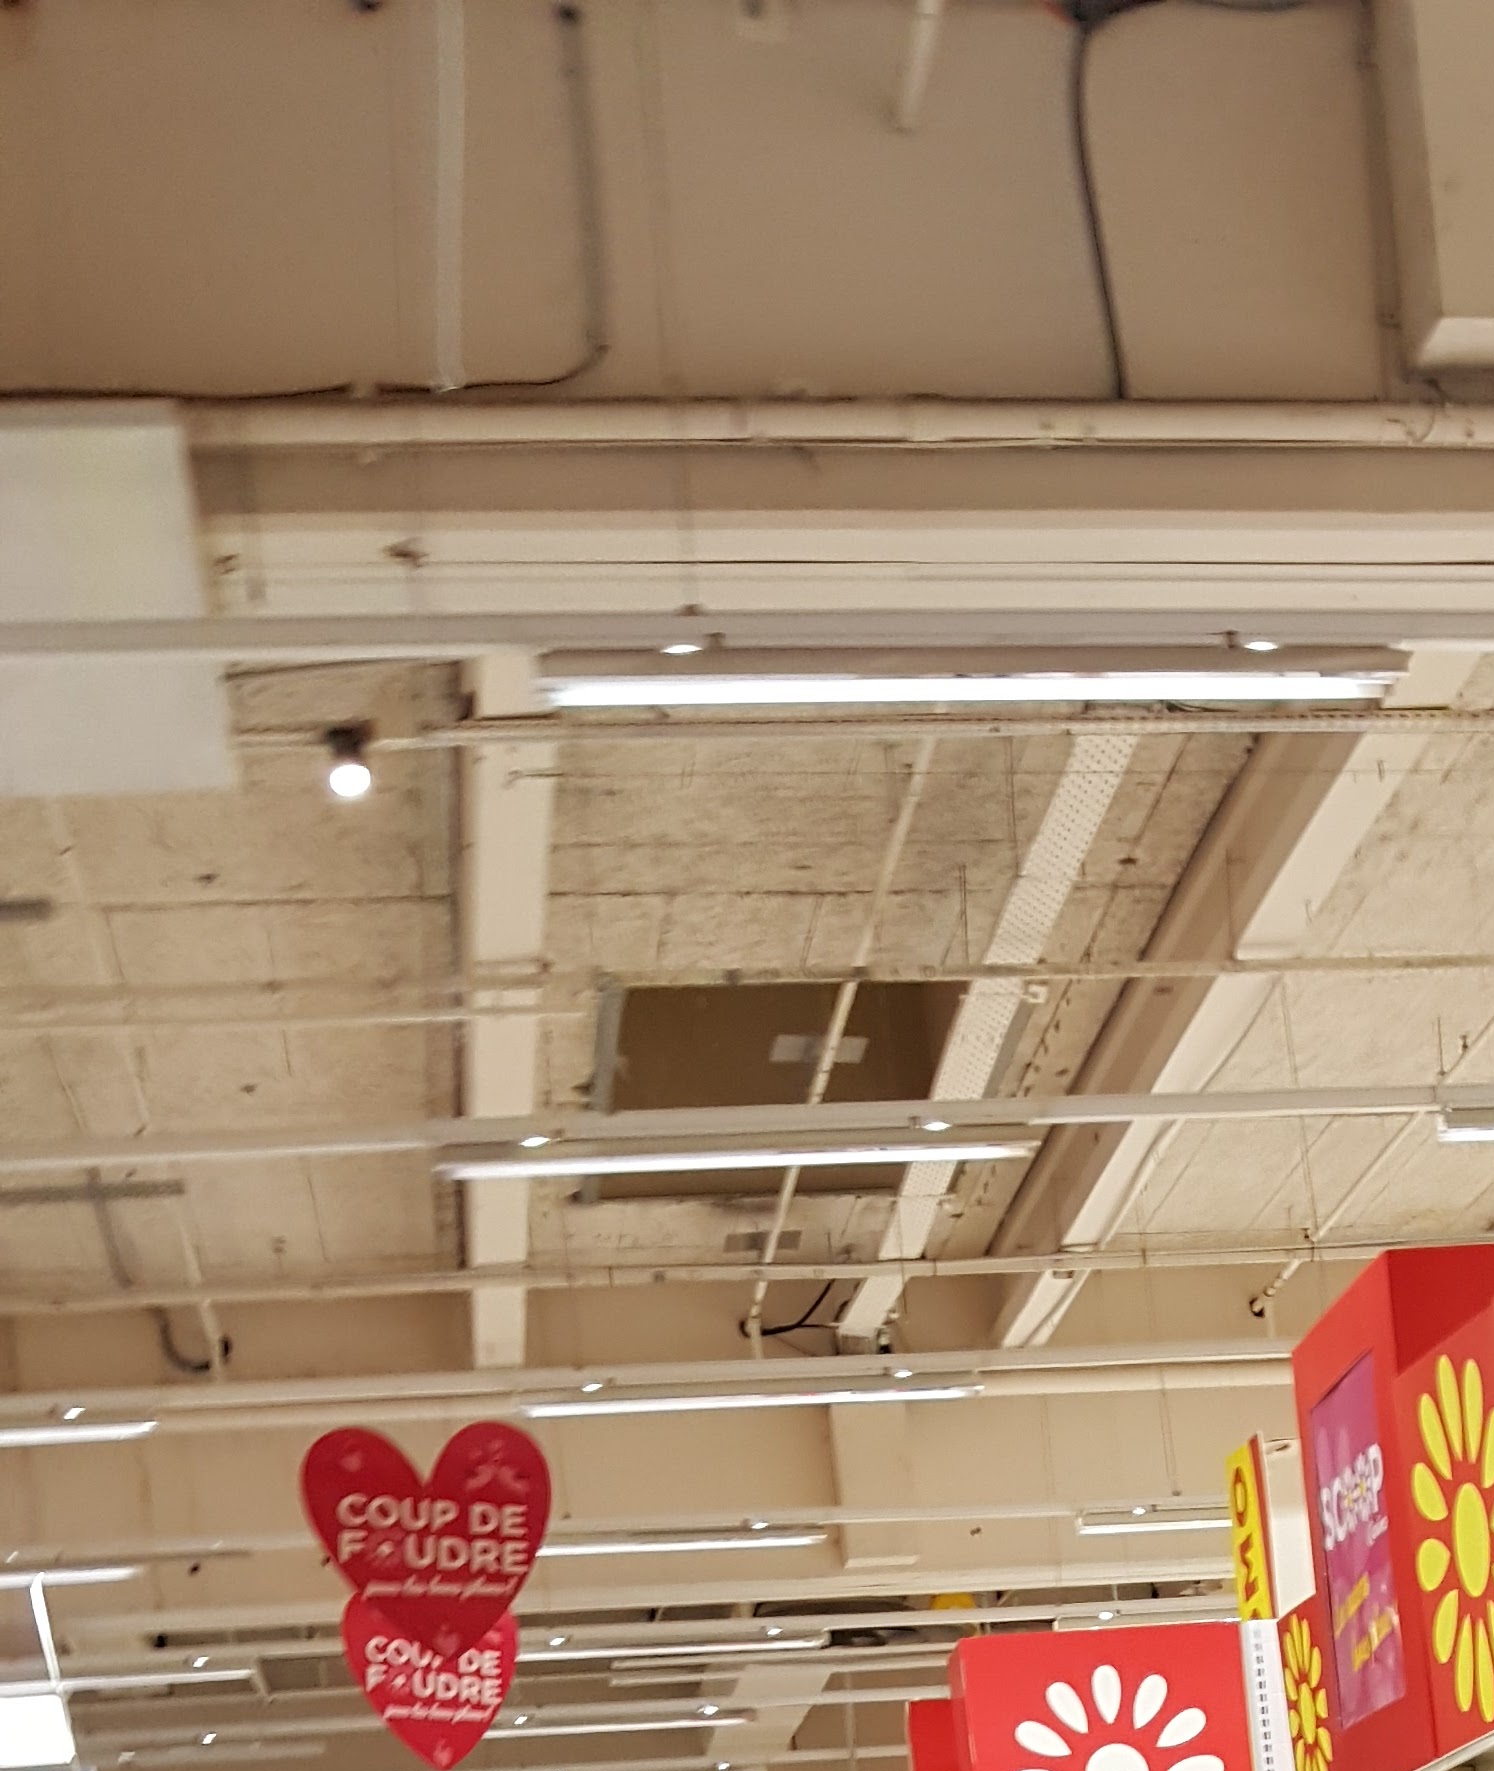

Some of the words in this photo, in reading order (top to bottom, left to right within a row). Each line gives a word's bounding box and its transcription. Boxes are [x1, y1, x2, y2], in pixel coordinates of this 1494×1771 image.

[336, 1492, 459, 1533] COUP
[468, 1502, 529, 1538] DE
[458, 1648, 502, 1676] DE
